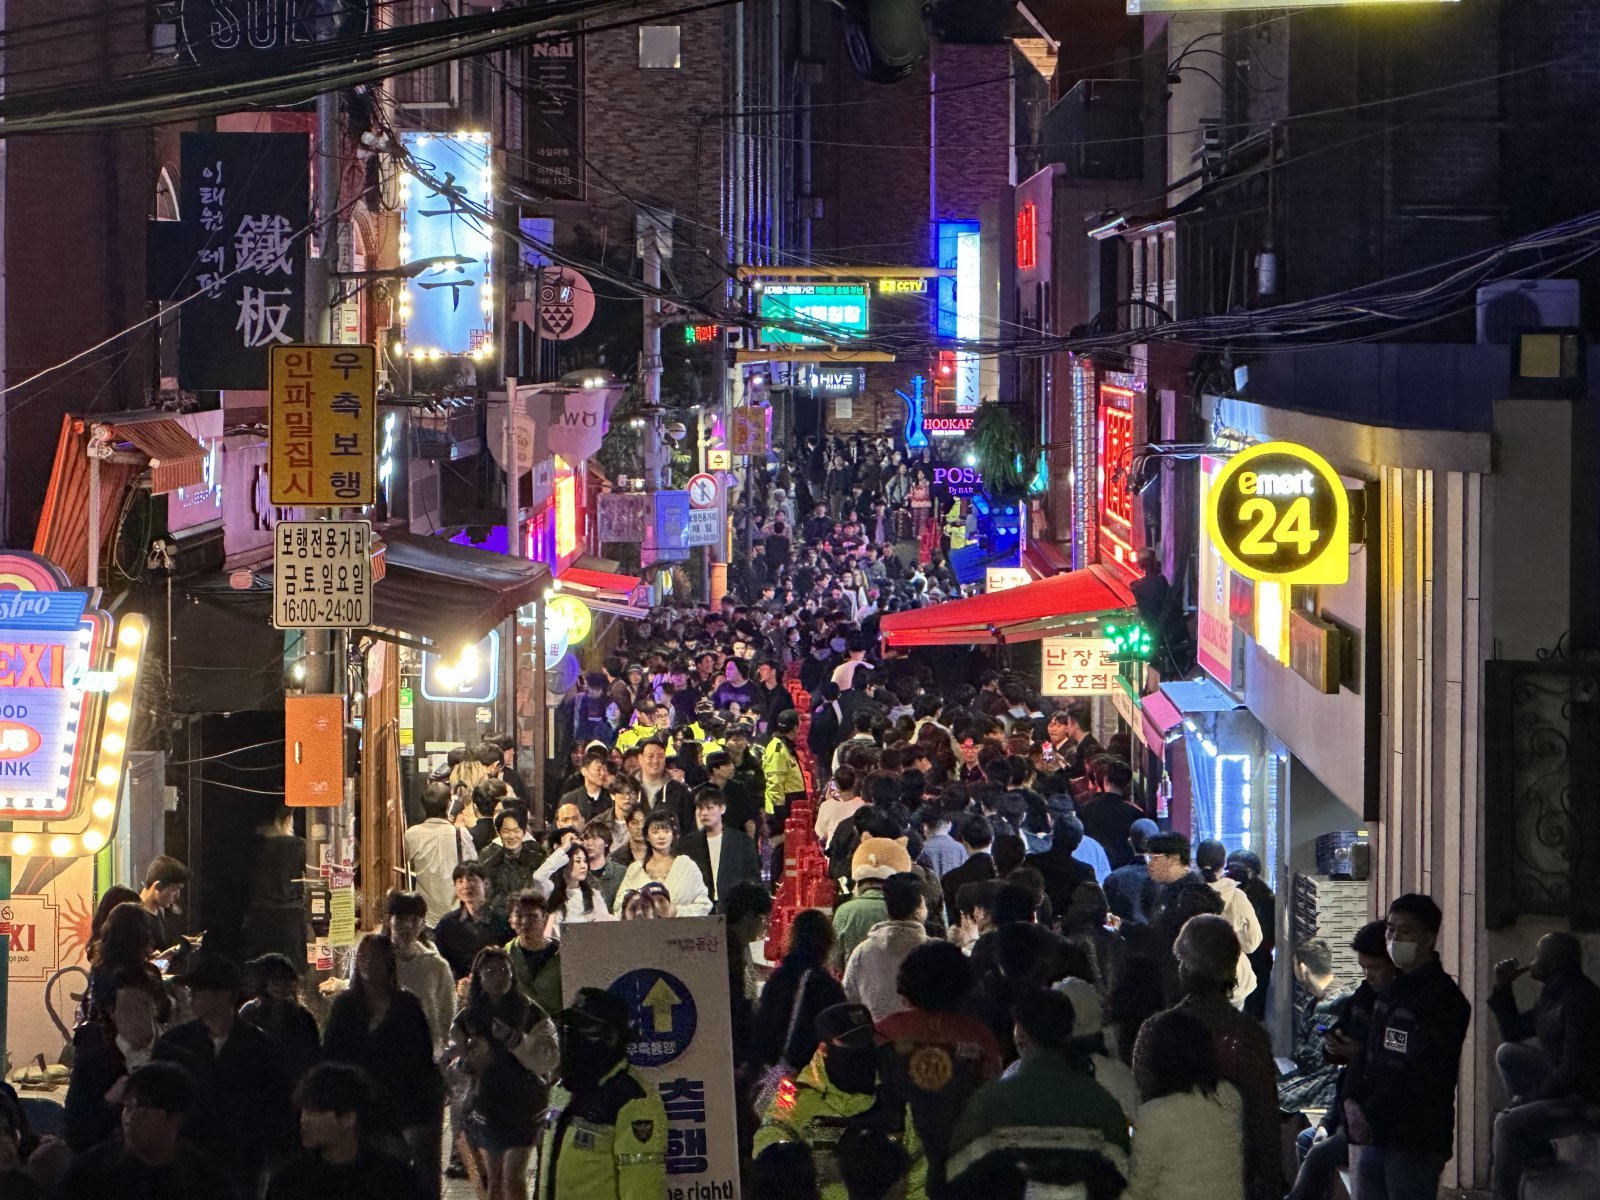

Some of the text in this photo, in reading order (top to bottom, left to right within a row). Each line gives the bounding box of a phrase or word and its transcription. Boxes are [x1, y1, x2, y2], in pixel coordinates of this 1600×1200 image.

[532, 42, 574, 58] Nail
[200, 160, 225, 231] 이태원
[234, 214, 294, 348] 鐵板
[896, 281, 923, 291] CCTV
[820, 373, 853, 385] HIVE
[283, 351, 316, 498] 인파밀집시
[329, 352, 363, 498] 우측보행
[1238, 469, 1315, 495] emart
[1238, 497, 1320, 555] 24
[282, 527, 364, 558] 보행전용거리
[284, 564, 364, 596] 금.토.일요일
[282, 598, 362, 623] 16:00~24:00
[1057, 674, 1108, 690] 2호점
[0, 705, 28, 719] OD
